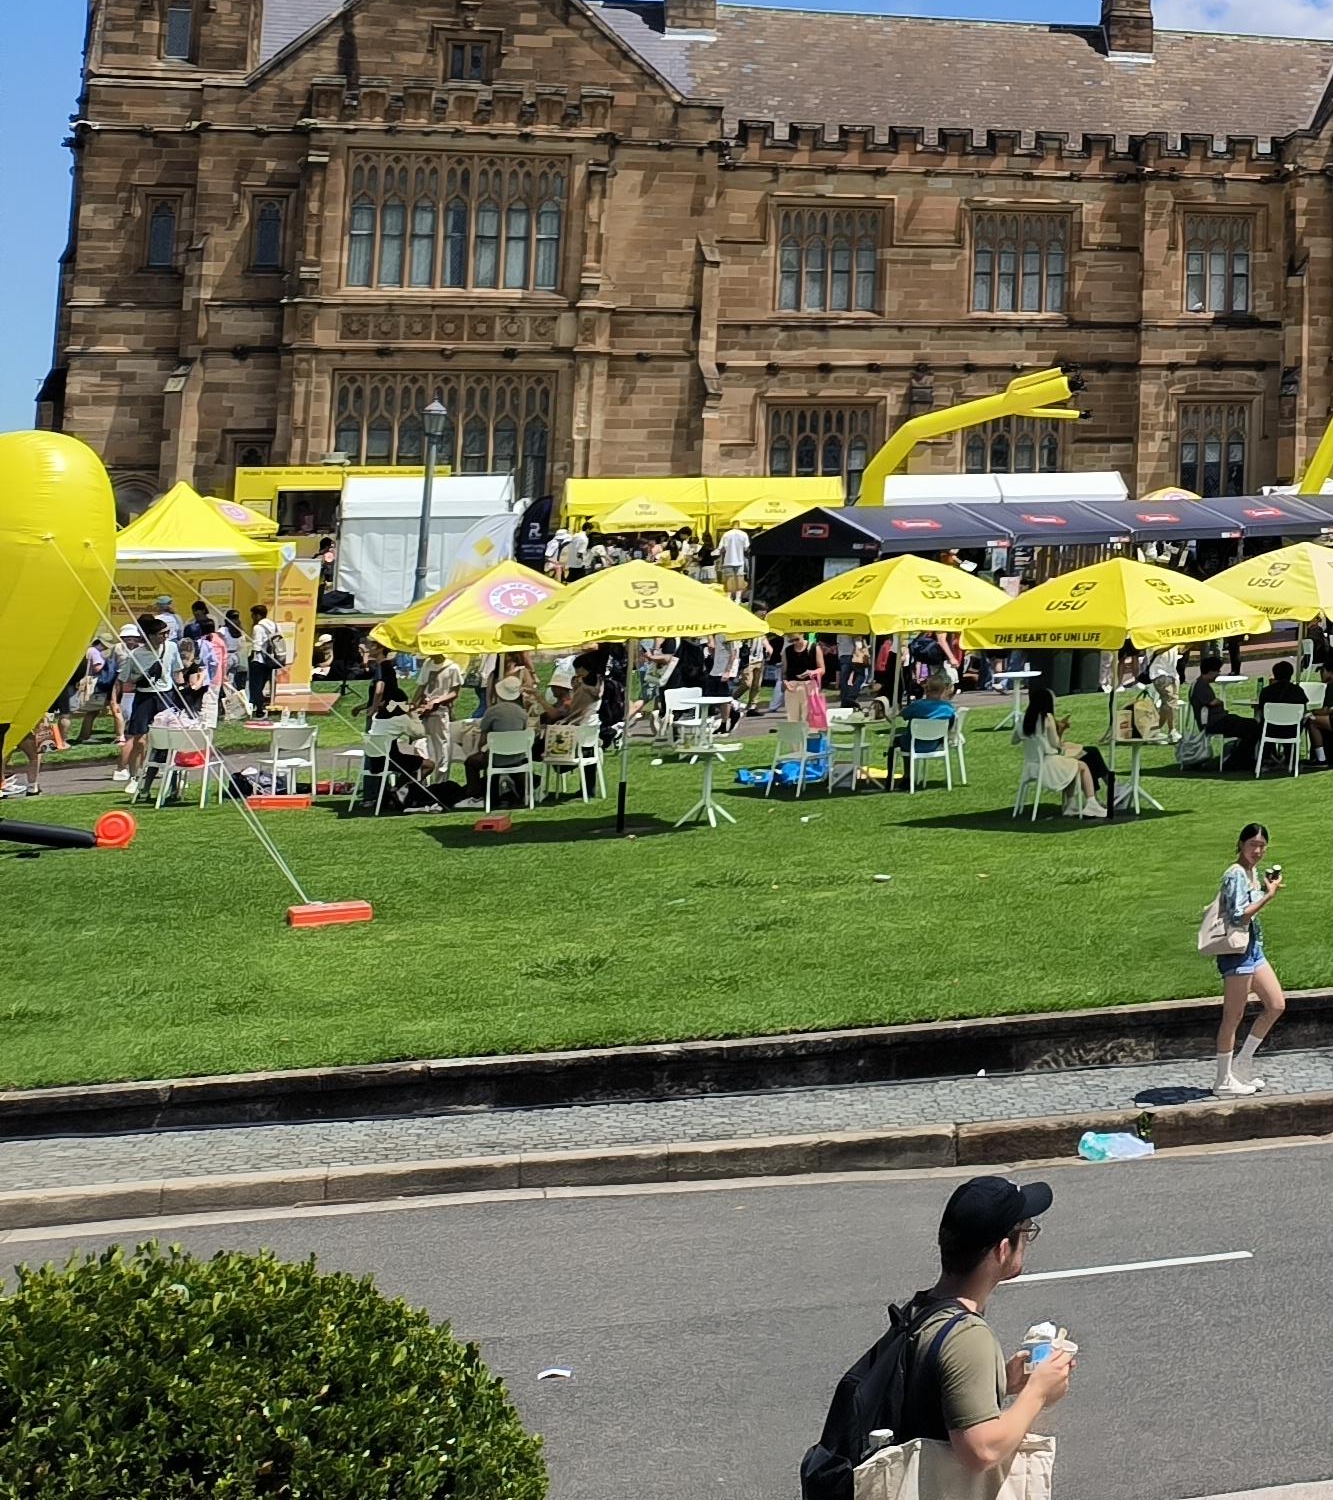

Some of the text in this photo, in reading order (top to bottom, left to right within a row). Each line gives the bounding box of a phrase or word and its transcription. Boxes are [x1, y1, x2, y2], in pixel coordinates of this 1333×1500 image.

[1247, 577, 1285, 589] USU
[829, 590, 862, 601] USU
[921, 590, 961, 600] USU
[1157, 593, 1195, 606] USU
[624, 598, 674, 610] USU
[1046, 600, 1088, 611] USU
[901, 617, 920, 626] THE
[921, 617, 952, 626] HEART
[954, 617, 966, 626] OF
[583, 622, 727, 637] THE HEART OF UNI LIFE
[1156, 619, 1245, 638] THE HEART OF UNI LIFE
[429, 638, 450, 647] USU
[465, 638, 485, 647] USU
[994, 632, 1102, 644] THE HEART OF UNI LIFE
